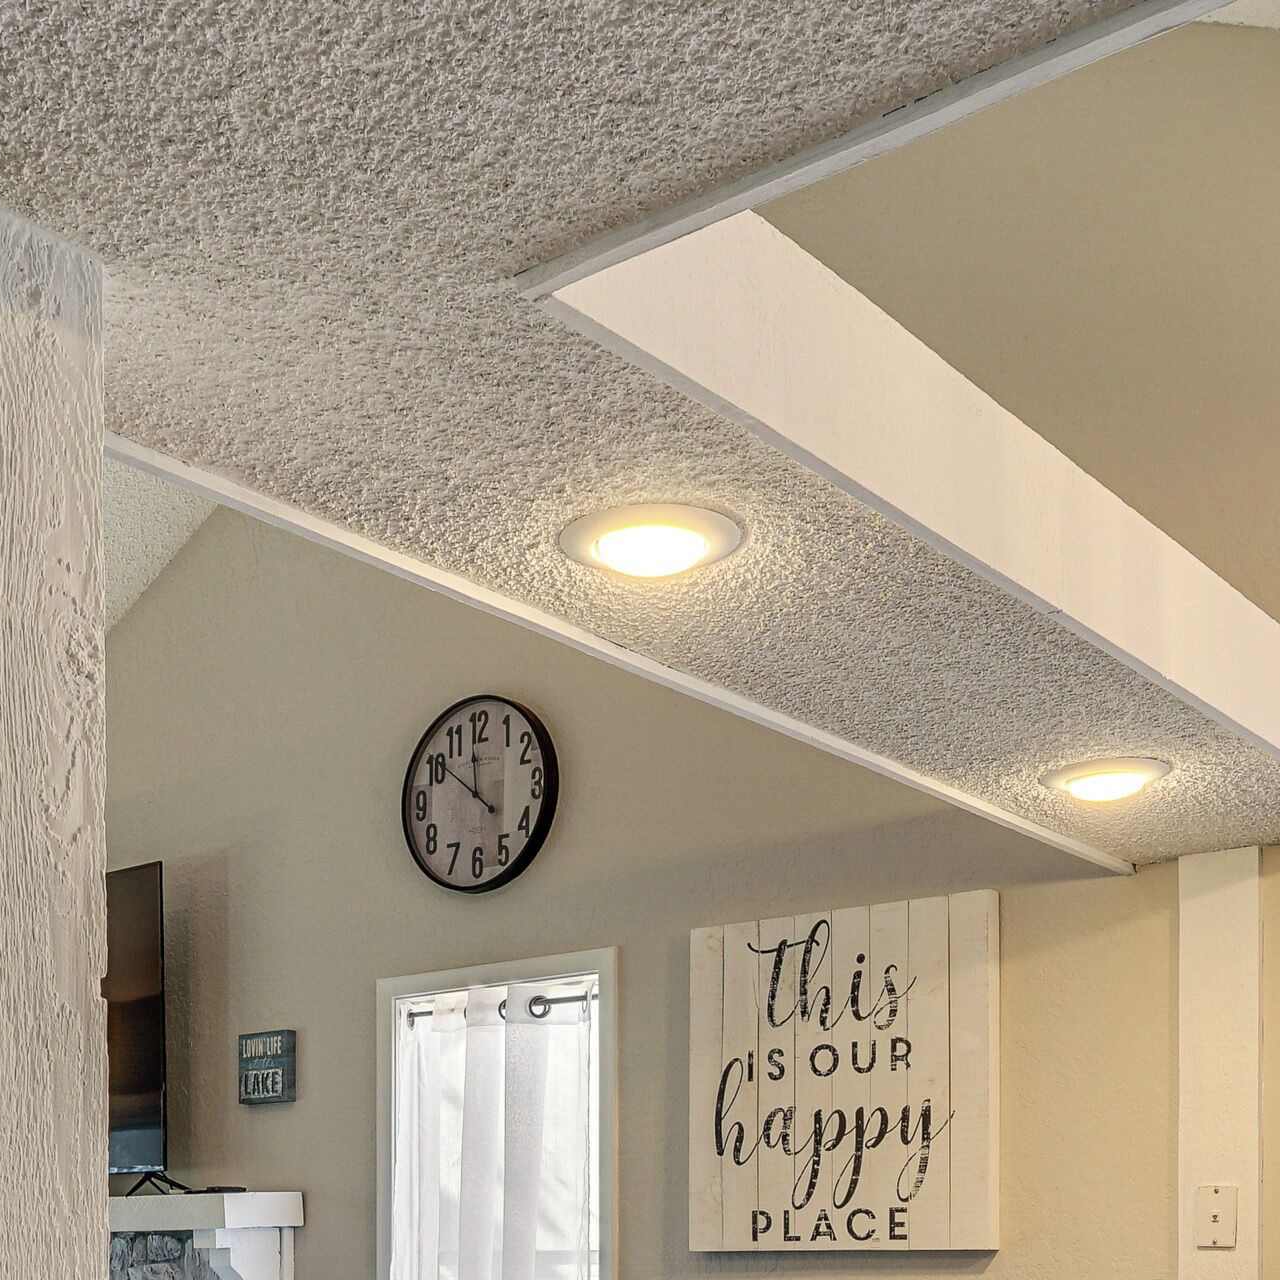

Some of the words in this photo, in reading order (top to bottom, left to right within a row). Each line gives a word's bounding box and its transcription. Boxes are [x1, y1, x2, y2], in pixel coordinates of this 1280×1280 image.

[446, 724, 462, 759] 11
[469, 710, 489, 744] 12
[502, 714, 510, 747] 1
[520, 731, 532, 765] 2
[426, 752, 446, 786] 10
[531, 767, 543, 799] 3
[416, 790, 427, 822] 9
[517, 806, 530, 838] 4
[426, 823, 438, 855] 8
[497, 833, 509, 866] 5
[446, 842, 460, 875] 7
[472, 847, 484, 879] 6
[266, 1035, 282, 1056] LIFE
[747, 1048, 786, 1082] IS
[809, 1036, 912, 1078] OUR
[244, 1070, 282, 1096] LAKE
[714, 1057, 956, 1211] happy
[752, 1206, 909, 1242] PLACE
